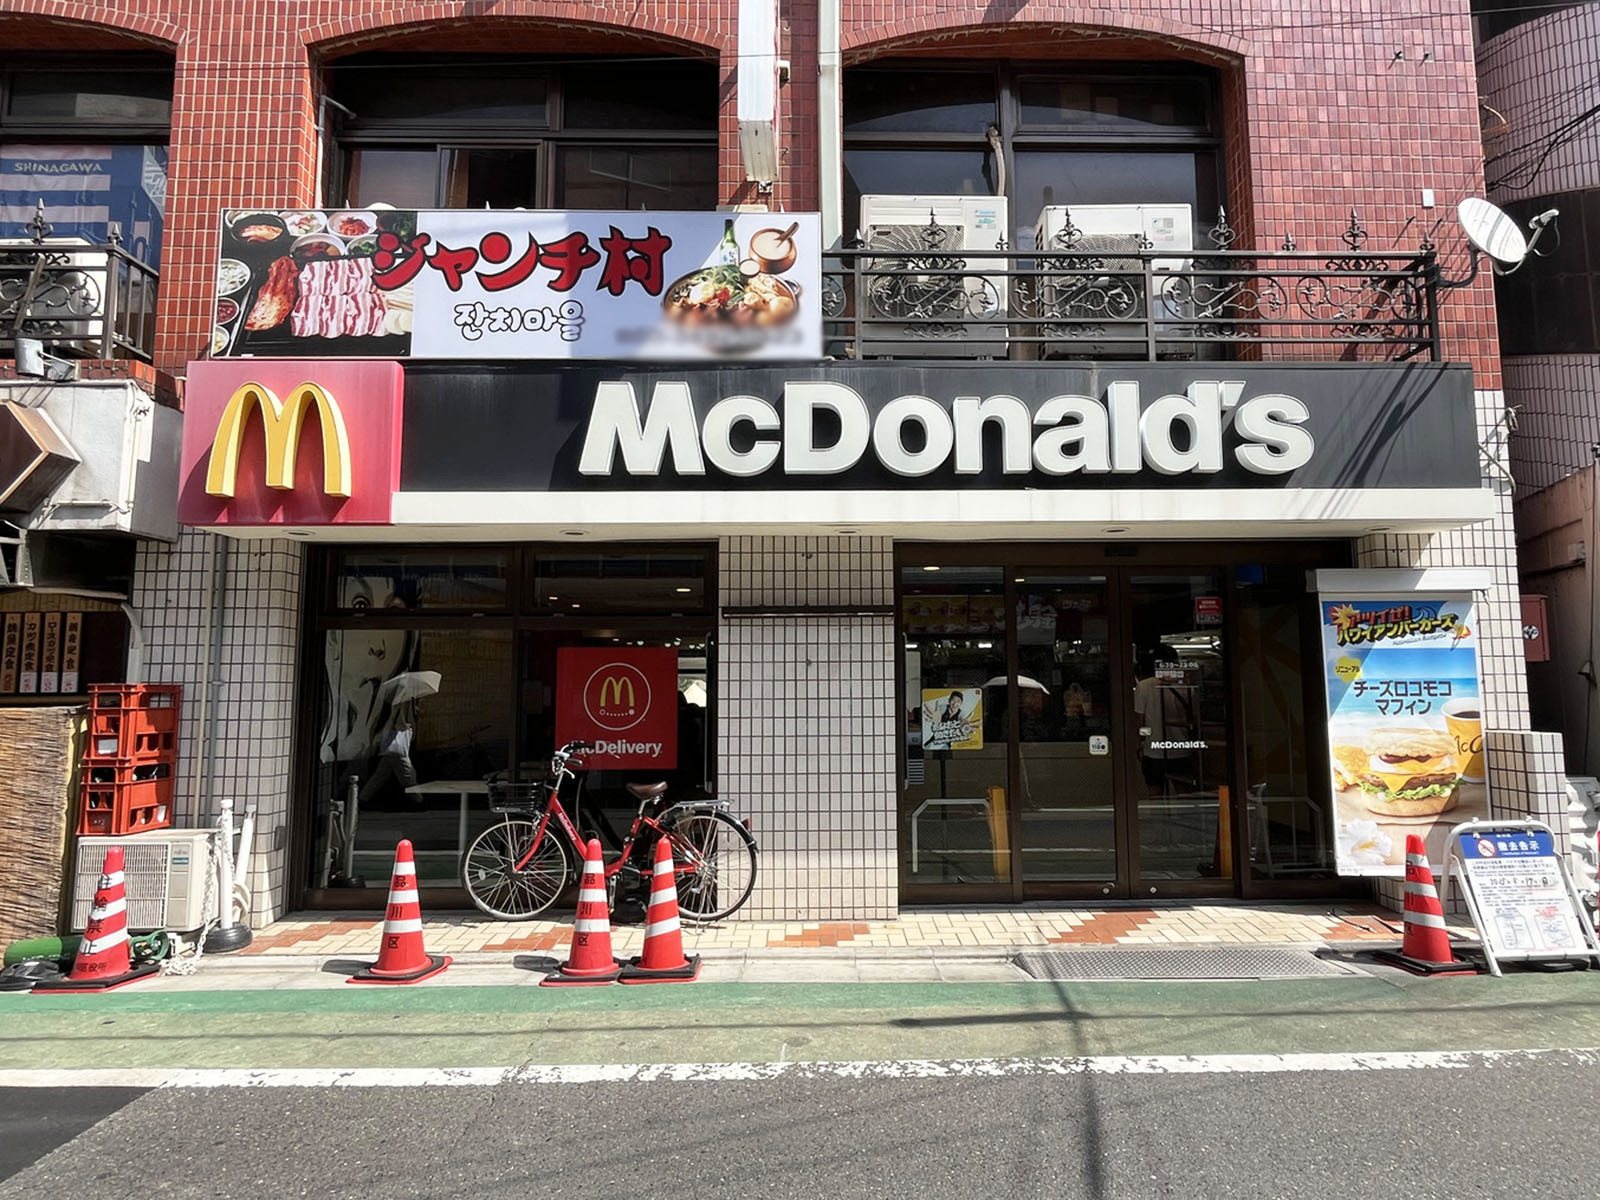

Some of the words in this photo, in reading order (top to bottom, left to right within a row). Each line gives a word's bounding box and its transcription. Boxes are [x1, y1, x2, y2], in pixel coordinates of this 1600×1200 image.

[14, 162, 102, 174] SHINAGAWA
[371, 225, 672, 297] ジャンチ村
[453, 299, 586, 342] 잔치마을
[578, 380, 1315, 477] McDonald's
[1337, 613, 1459, 647] ハワイアンバーガーズ
[1353, 680, 1452, 698] チーズロコモコ
[1375, 699, 1432, 716] マフィン
[387, 875, 407, 949] 品川区
[578, 873, 595, 947] 品川区
